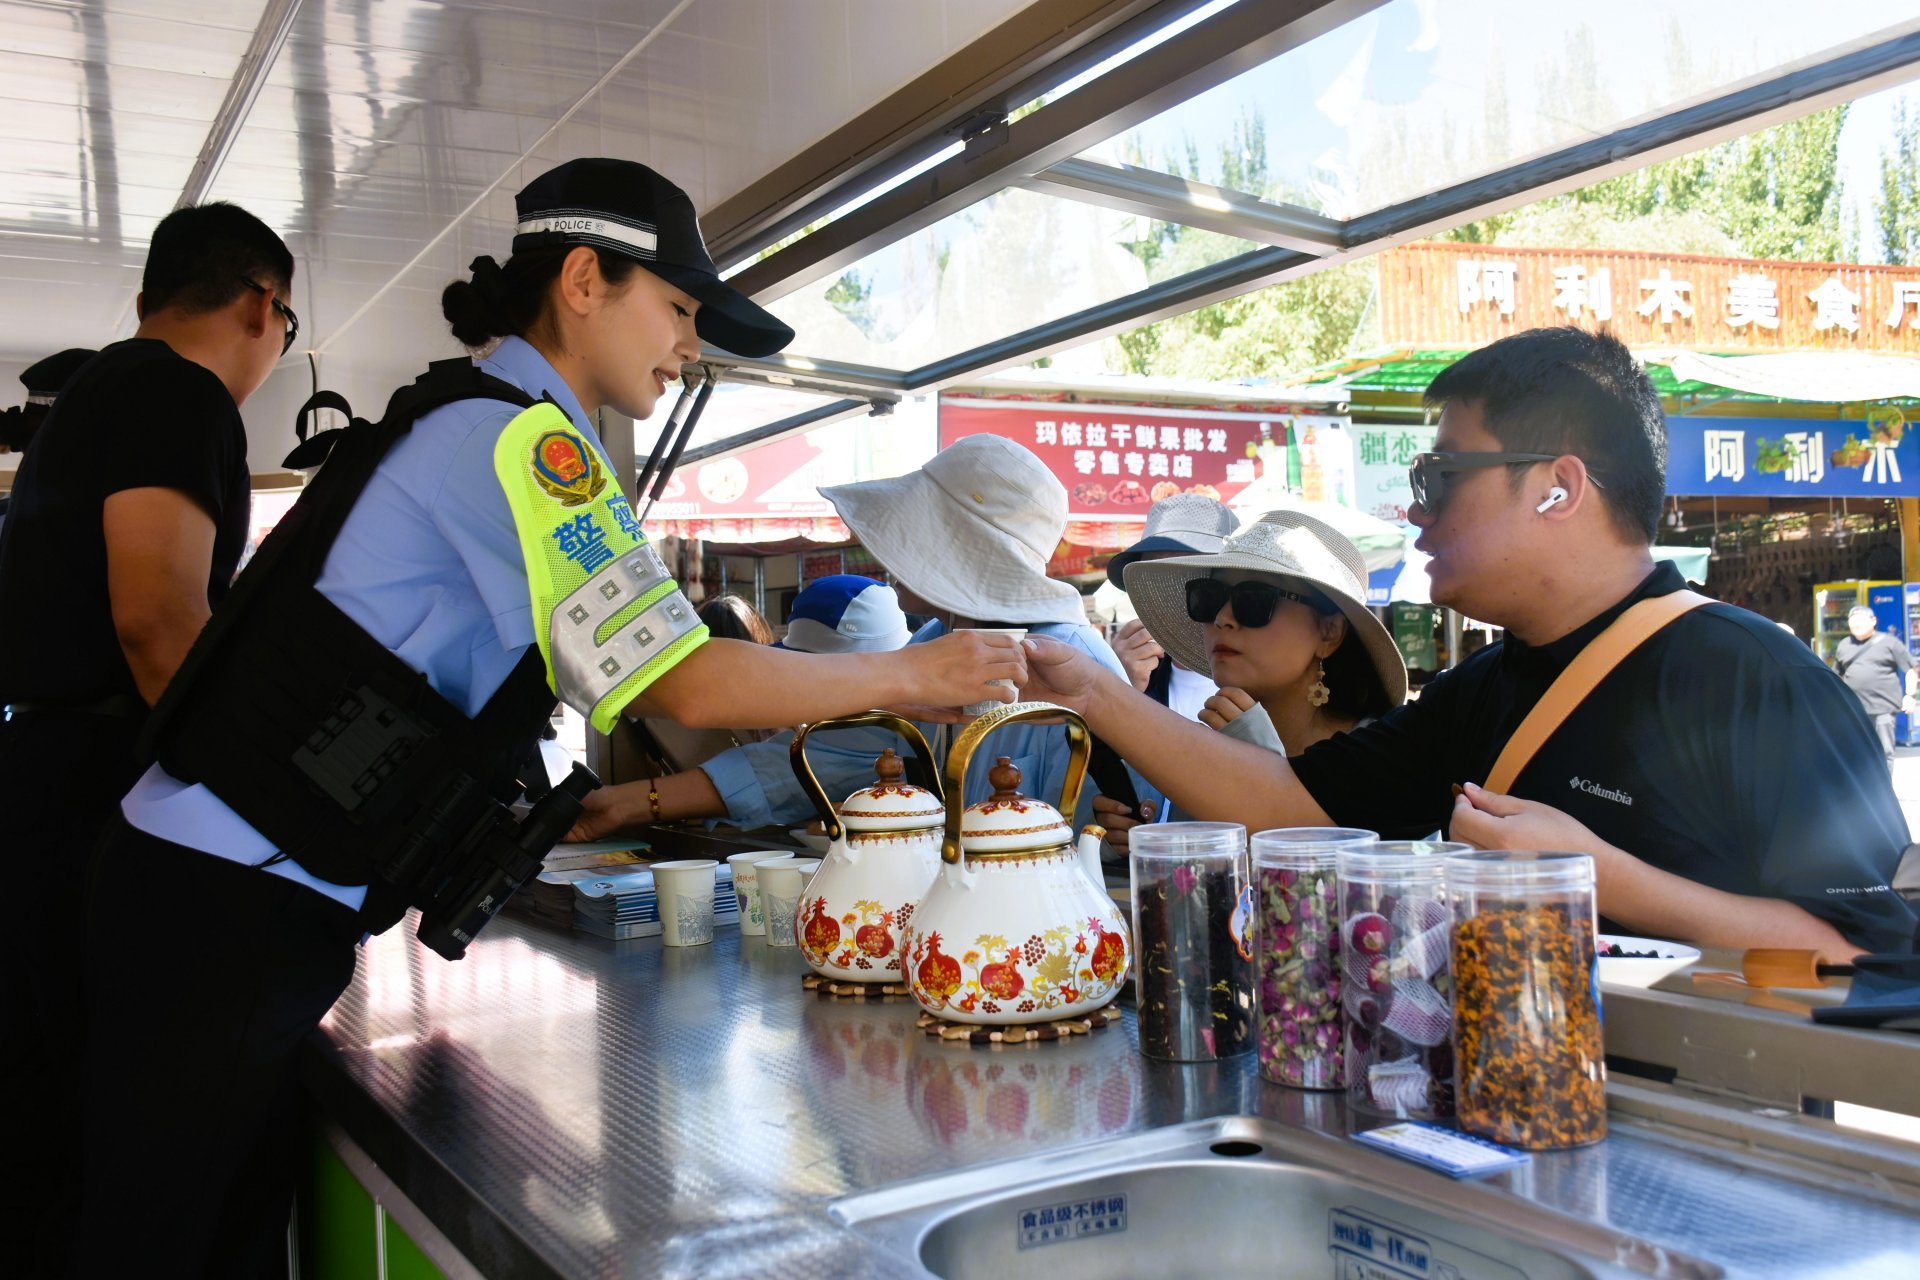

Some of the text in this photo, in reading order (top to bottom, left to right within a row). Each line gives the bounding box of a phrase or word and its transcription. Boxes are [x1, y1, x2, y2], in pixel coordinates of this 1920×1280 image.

[554, 220, 592, 230] POLICE
[1035, 421, 1227, 453] 玛依拉干鲜果批发
[1359, 431, 1435, 466] 疆恋
[1073, 449, 1194, 478] 零售专卖店
[1704, 429, 1902, 484] 阿利木
[1580, 779, 1633, 806] Columbia
[1022, 1197, 1125, 1229] 食品级不锈钢
